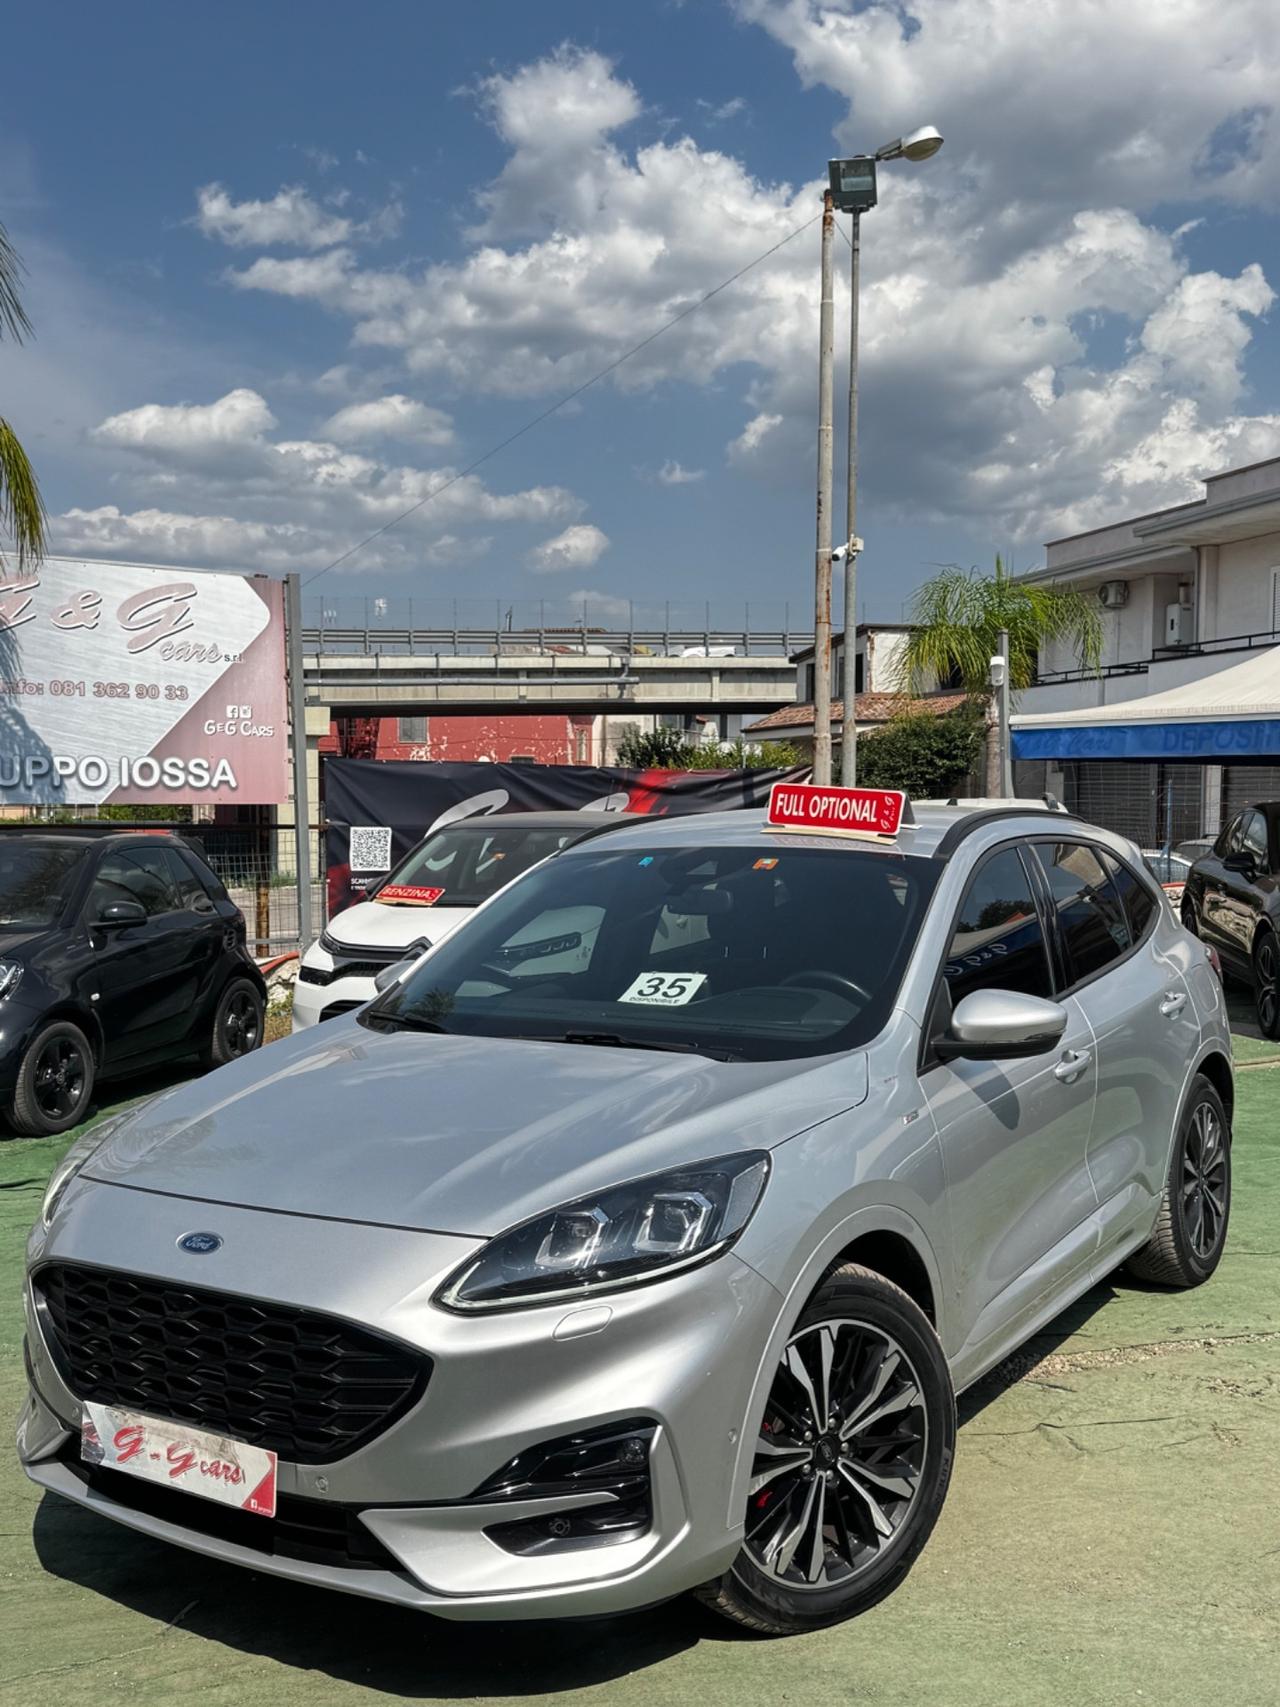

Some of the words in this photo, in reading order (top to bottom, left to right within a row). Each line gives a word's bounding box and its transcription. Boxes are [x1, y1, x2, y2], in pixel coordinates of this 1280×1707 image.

[50, 590, 103, 630] &
[116, 582, 198, 654] G
[160, 640, 224, 664] cars
[50, 680, 86, 697] 081
[93, 681, 130, 698] 362
[135, 684, 160, 699] 90
[165, 685, 189, 700] 33
[119, 757, 238, 789] IOSSA
[775, 793, 805, 817] FULL
[808, 795, 878, 823] OPTIONAL
[382, 886, 432, 898] BENZINA
[637, 976, 692, 999] 35
